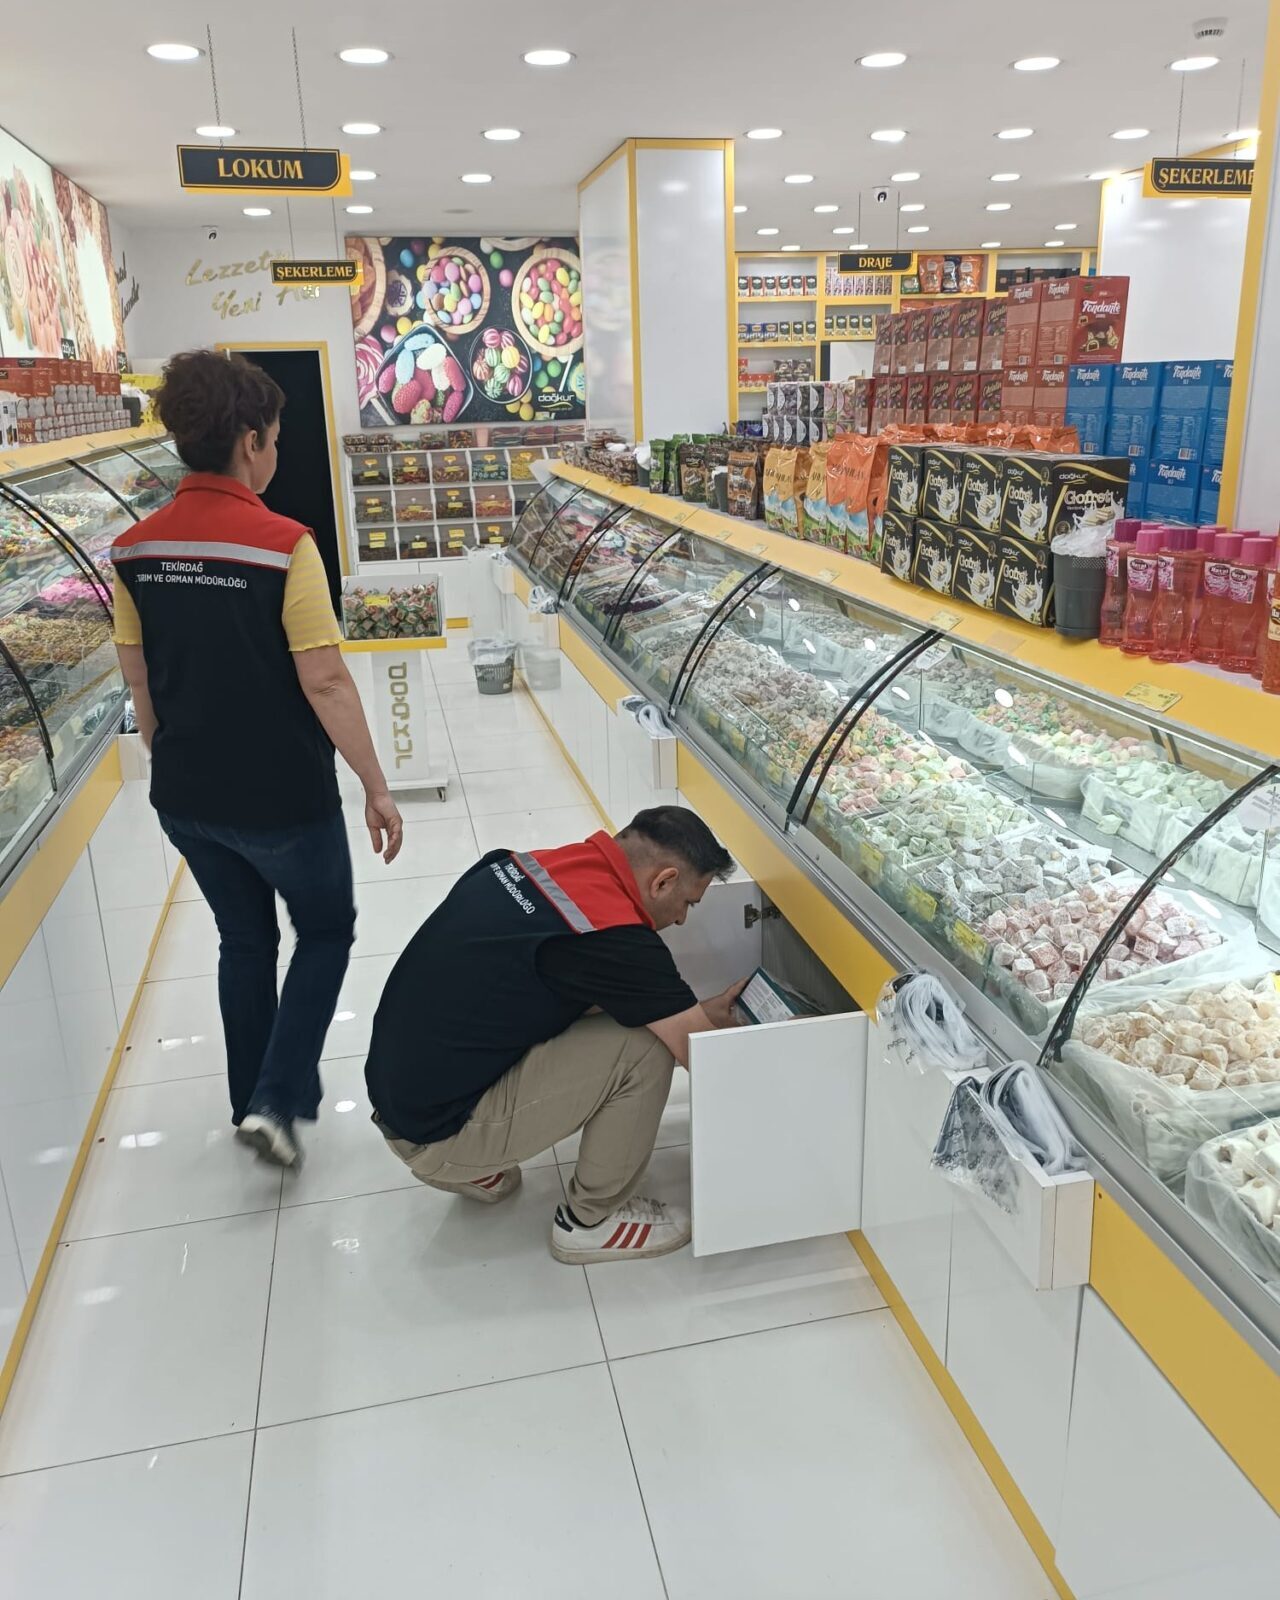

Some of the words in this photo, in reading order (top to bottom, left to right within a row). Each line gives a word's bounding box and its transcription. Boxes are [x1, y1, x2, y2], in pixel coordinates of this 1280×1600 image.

[217, 157, 304, 180] LOKUM
[858, 257, 893, 270] DRAJE
[276, 265, 354, 281] ŞEKERLEME
[1082, 299, 1121, 315] Fondante
[538, 392, 575, 403] doğkur
[1064, 489, 1112, 505] Gofret
[160, 560, 204, 573] TEKİRDAĞ
[153, 574, 163, 583] VE
[165, 574, 193, 585] ORMAN
[194, 574, 247, 589] MÜDÜRLÜĞÜ
[388, 661, 413, 769] doğkur
[504, 881, 536, 915] MÜDÜRLÜĞÜ
